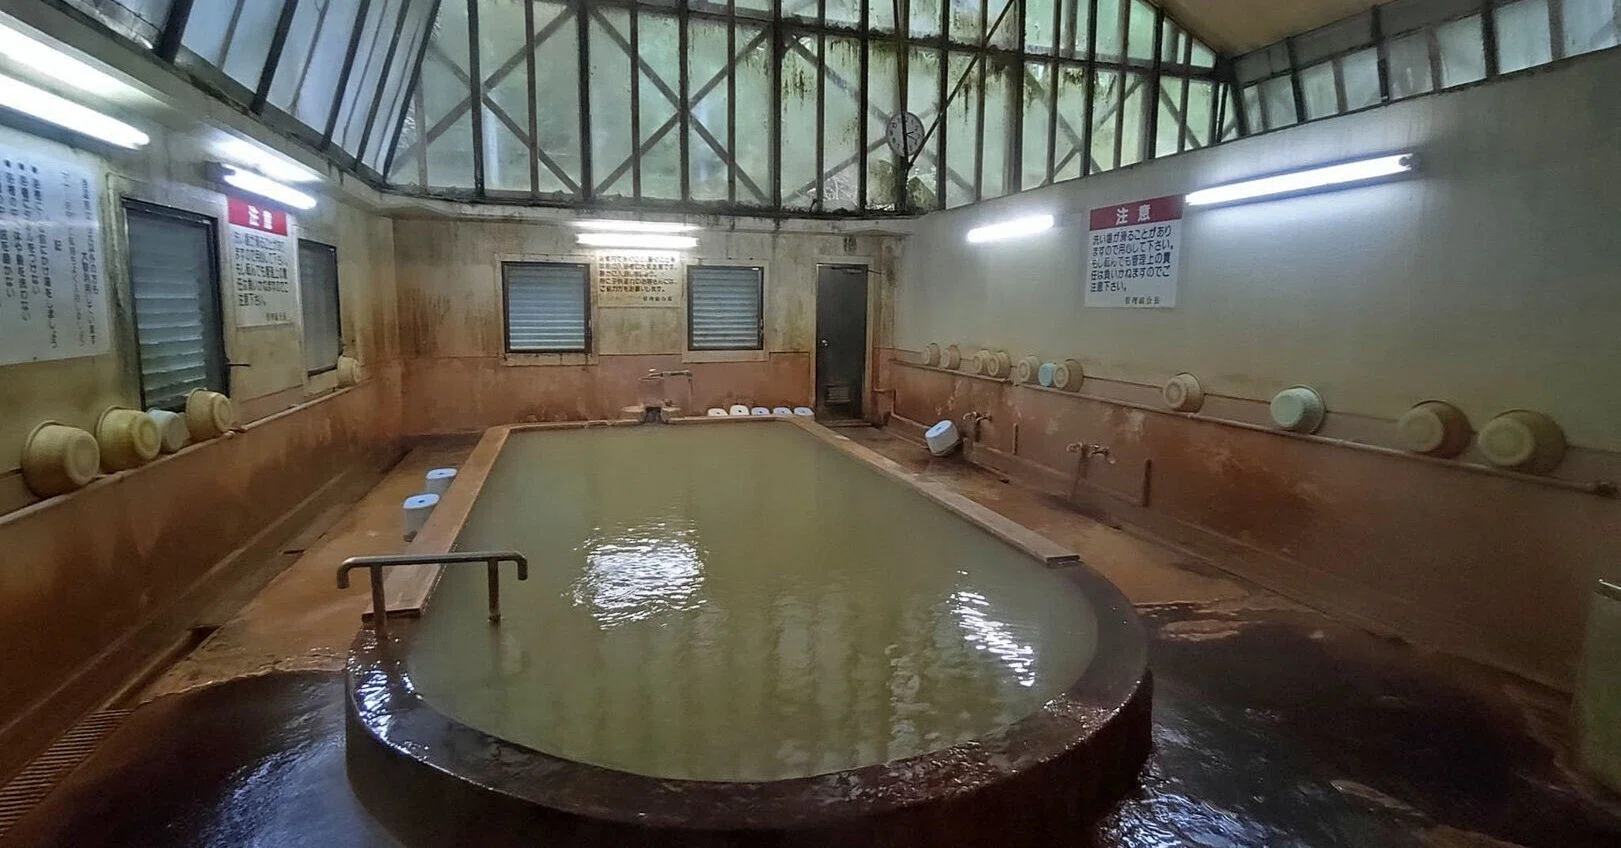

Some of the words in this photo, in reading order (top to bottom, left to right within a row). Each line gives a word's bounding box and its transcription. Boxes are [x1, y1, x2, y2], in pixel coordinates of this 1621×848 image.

[248, 204, 273, 230] 注意
[1116, 204, 1151, 225] 注意
[1092, 239, 1174, 257] ますので用心して下さい。
[1090, 280, 1127, 293] 注意下さい。
